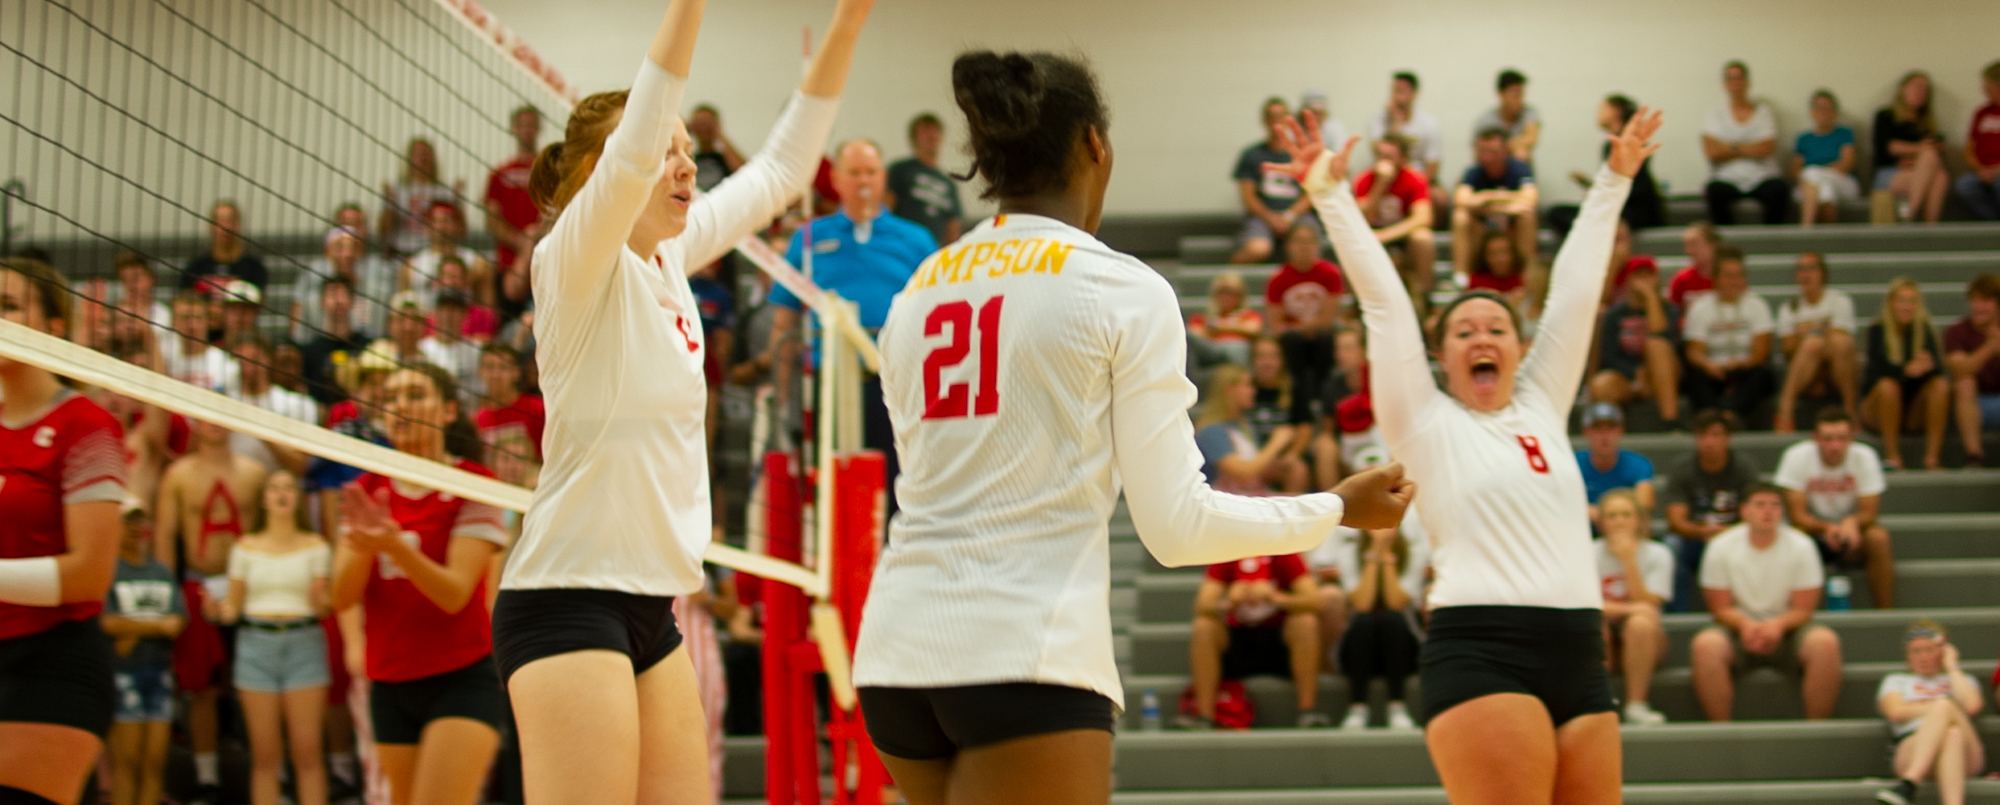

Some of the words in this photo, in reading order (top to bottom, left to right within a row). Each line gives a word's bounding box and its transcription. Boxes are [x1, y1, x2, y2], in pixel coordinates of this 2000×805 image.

[921, 294, 1005, 421] 21
[1515, 434, 1551, 474] 8
[196, 477, 243, 562] A
